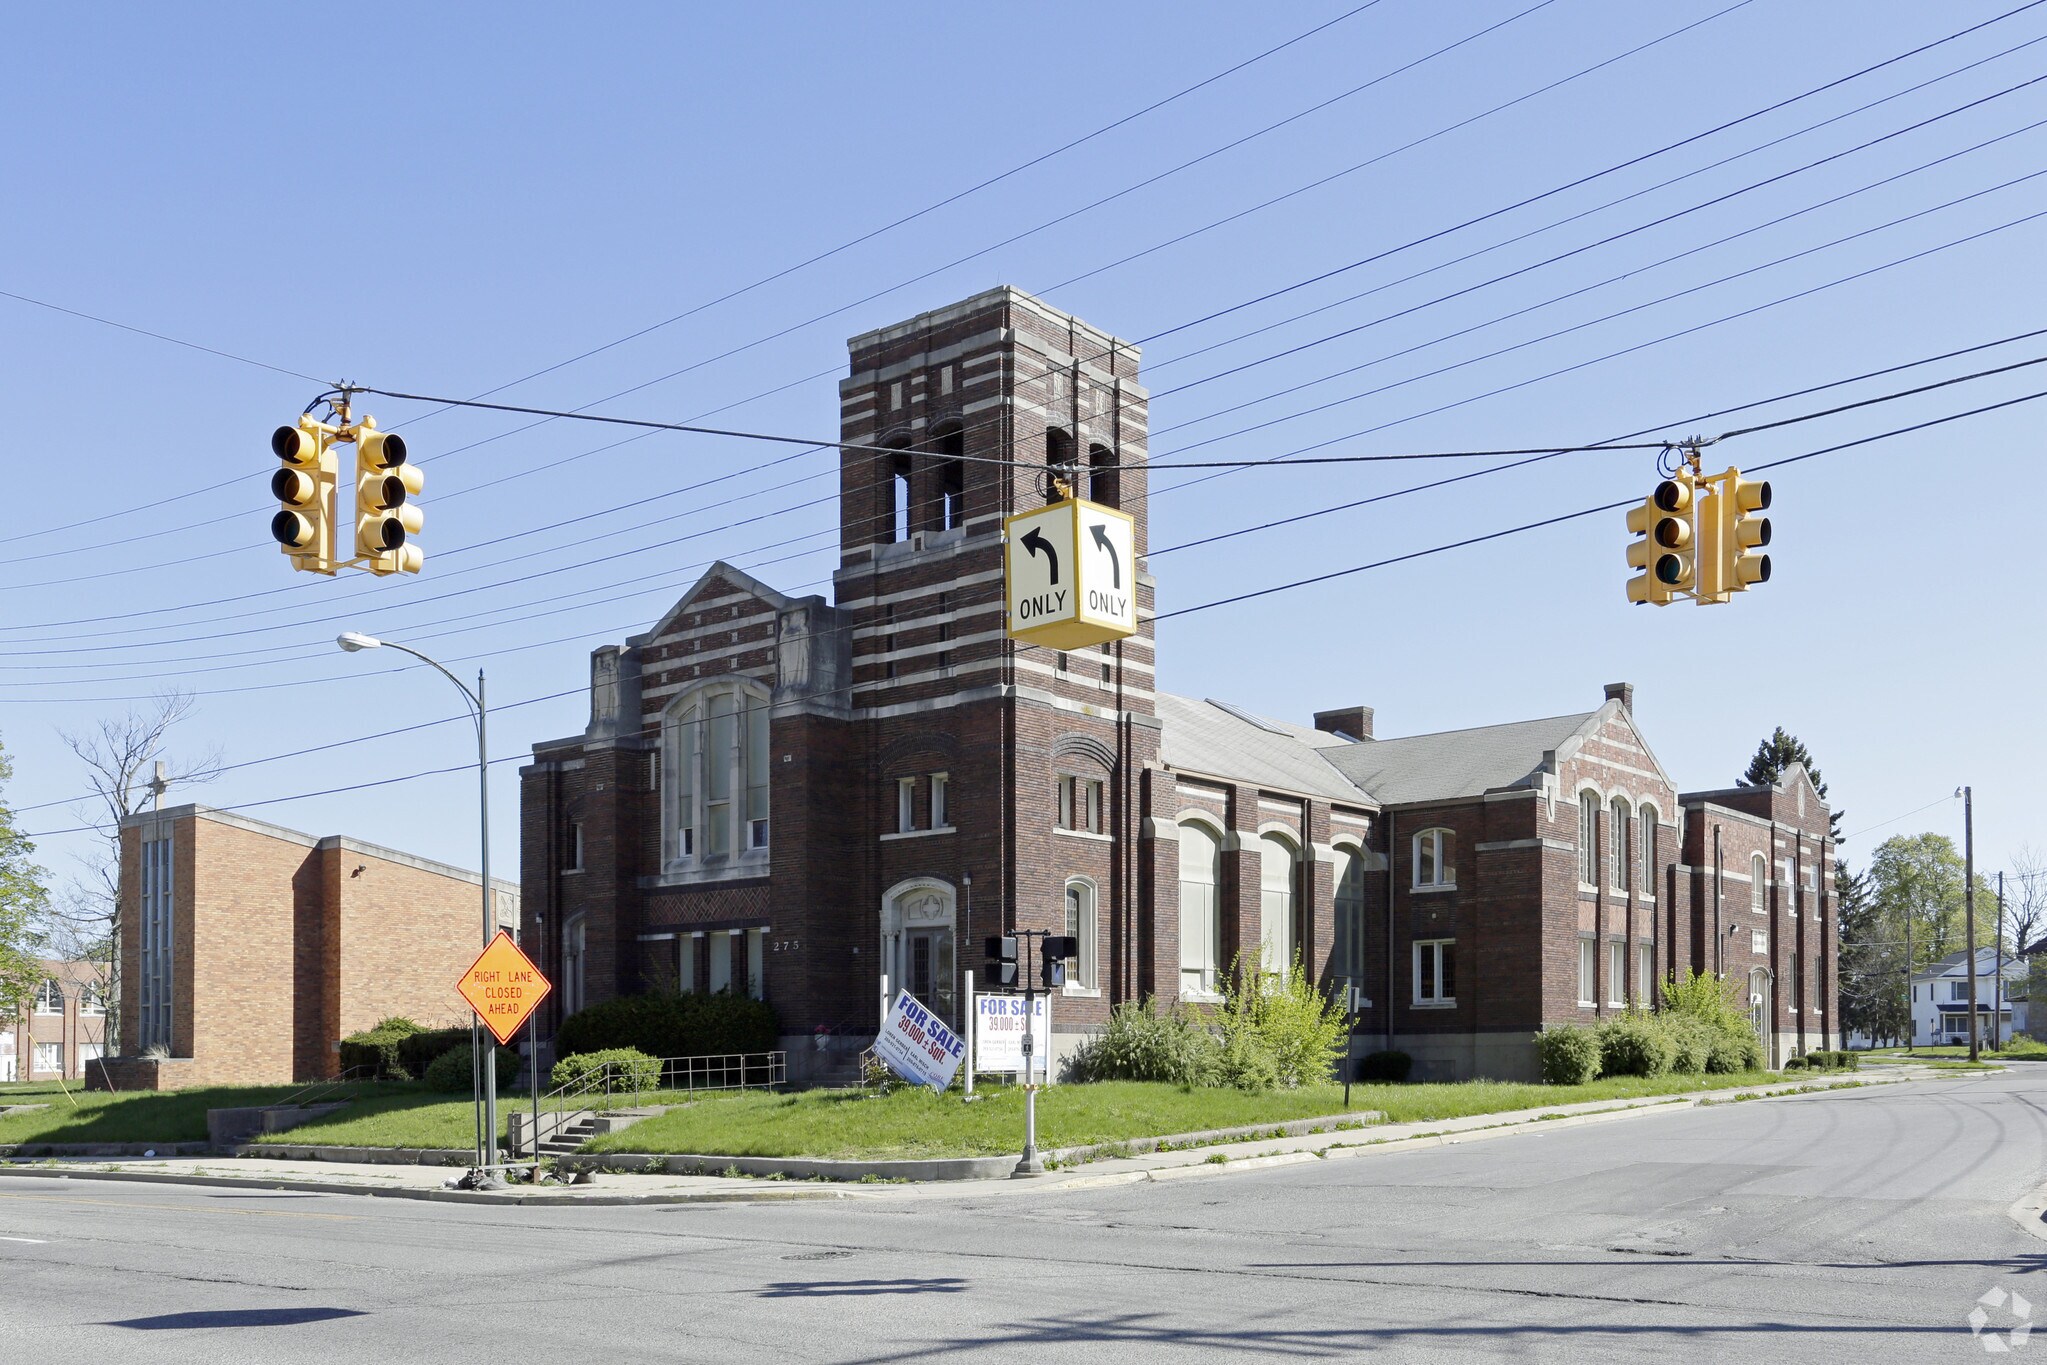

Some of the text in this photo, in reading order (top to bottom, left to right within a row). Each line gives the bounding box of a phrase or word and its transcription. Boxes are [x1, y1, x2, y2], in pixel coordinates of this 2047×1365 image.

[1020, 590, 1066, 619] ONLY
[1089, 590, 1126, 617] ONLY
[773, 940, 799, 951] 275
[474, 971, 532, 982] RIGHT LANE
[486, 987, 522, 998] CLOSED
[488, 1003, 519, 1014] AHEAD
[981, 999, 1042, 1016] FOR SAE
[898, 995, 928, 1028] FOR
[927, 1020, 964, 1058] SALE
[898, 1015, 926, 1044] 39,000
